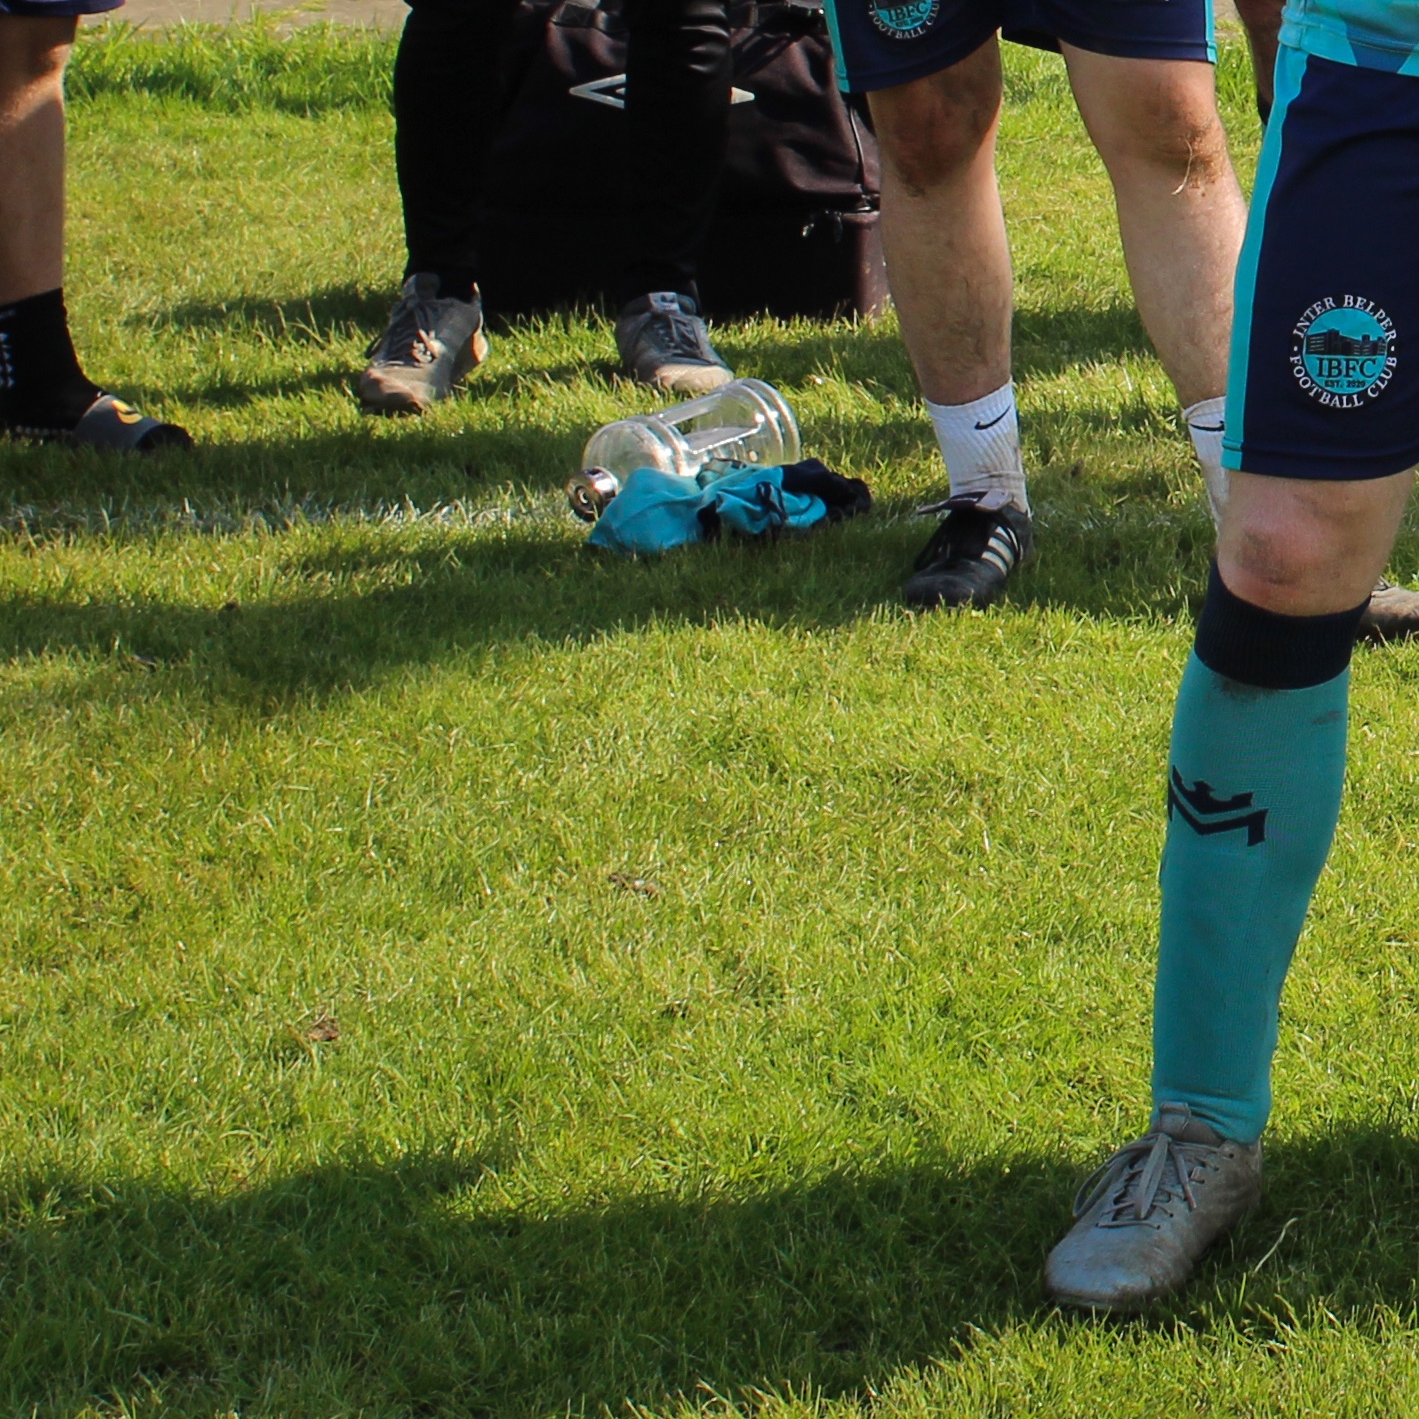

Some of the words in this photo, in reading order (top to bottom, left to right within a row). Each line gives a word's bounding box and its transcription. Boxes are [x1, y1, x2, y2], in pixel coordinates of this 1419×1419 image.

[887, 1, 927, 21] IBFC
[1293, 296, 1336, 338] INTER
[1343, 294, 1397, 343] BELPER
[1290, 356, 1363, 408] FOOTBALL
[1367, 356, 1397, 397] CLUB
[1316, 358, 1376, 378] IBFC
